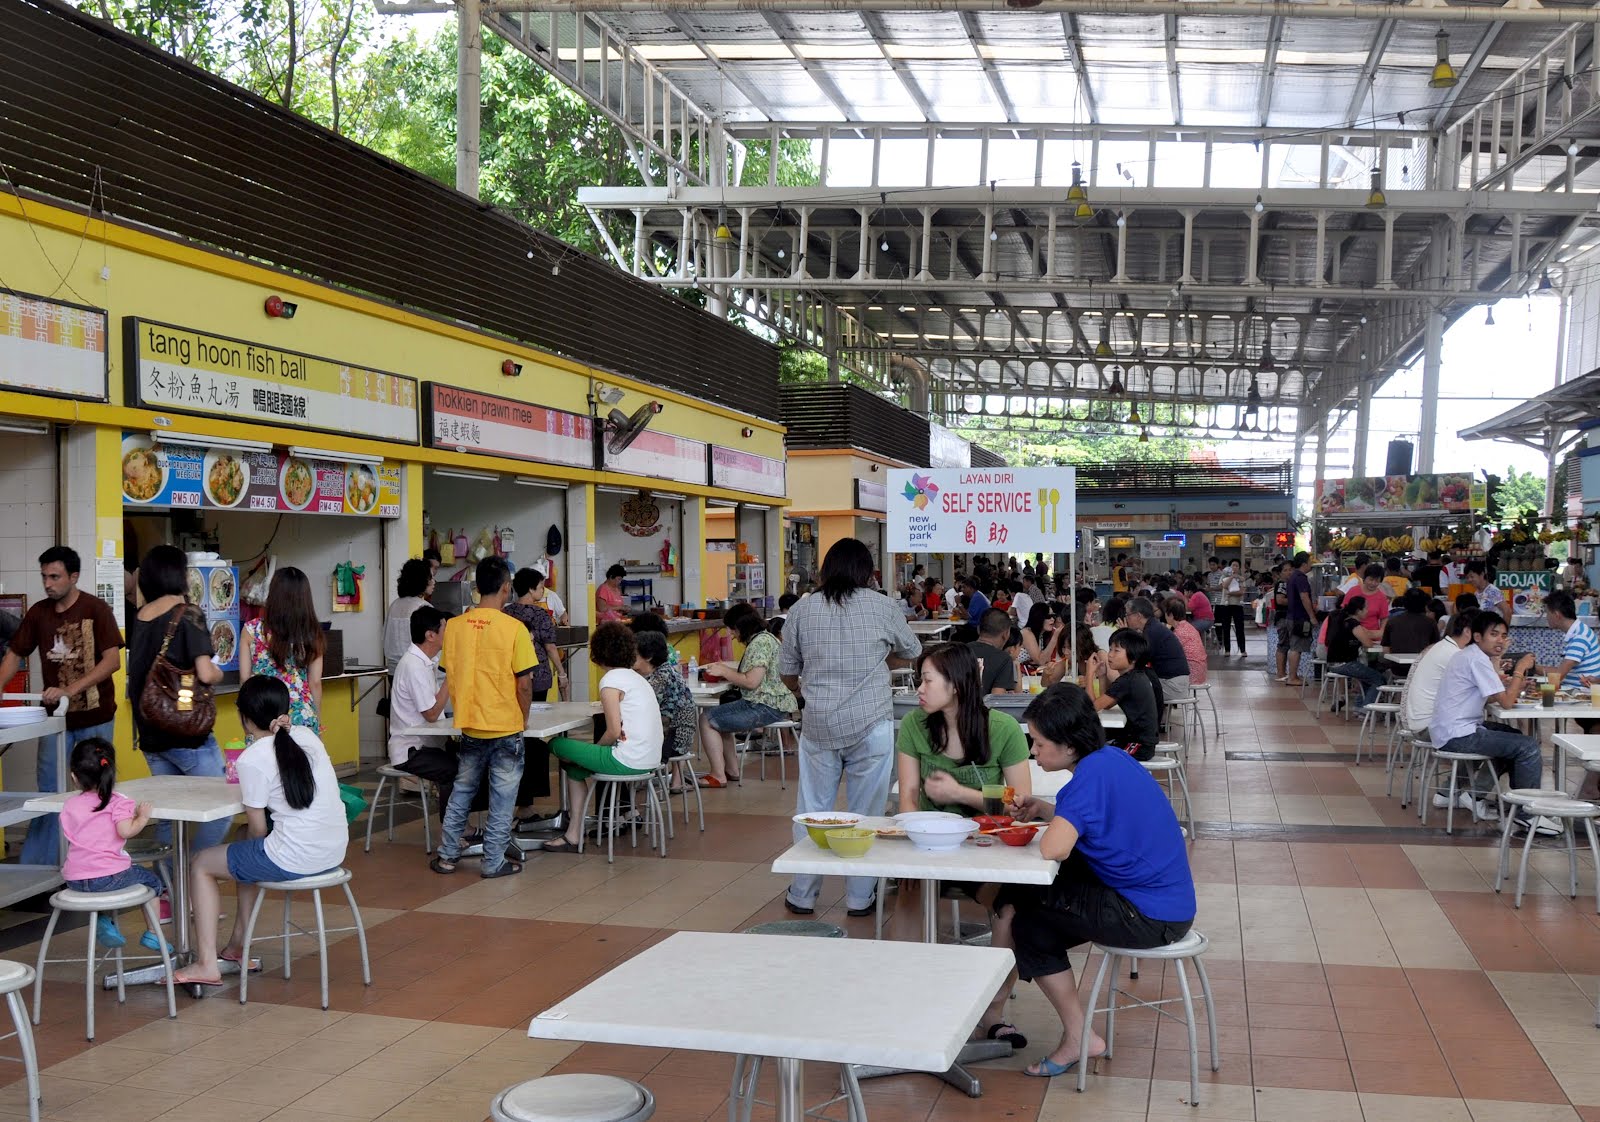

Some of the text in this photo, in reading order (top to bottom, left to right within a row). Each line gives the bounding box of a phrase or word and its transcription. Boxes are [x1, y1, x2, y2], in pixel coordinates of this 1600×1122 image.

[149, 327, 307, 381] tang hoon fish ball
[148, 366, 240, 409] 冬粉魚丸湯
[252, 388, 306, 418] 鴨腿麵線
[438, 388, 532, 424] hokkien prawn mee
[960, 473, 1014, 484] LAYAN DIRI
[172, 492, 200, 505] RM5.00
[250, 496, 276, 508] RM4.50
[942, 492, 1032, 513] SELF SERVICE
[319, 500, 342, 512] RM4.50
[380, 505, 399, 516] RM3.50
[909, 522, 937, 532] world
[965, 520, 1008, 546] 自助
[909, 531, 932, 541] park
[1499, 573, 1546, 588] ROJAK
